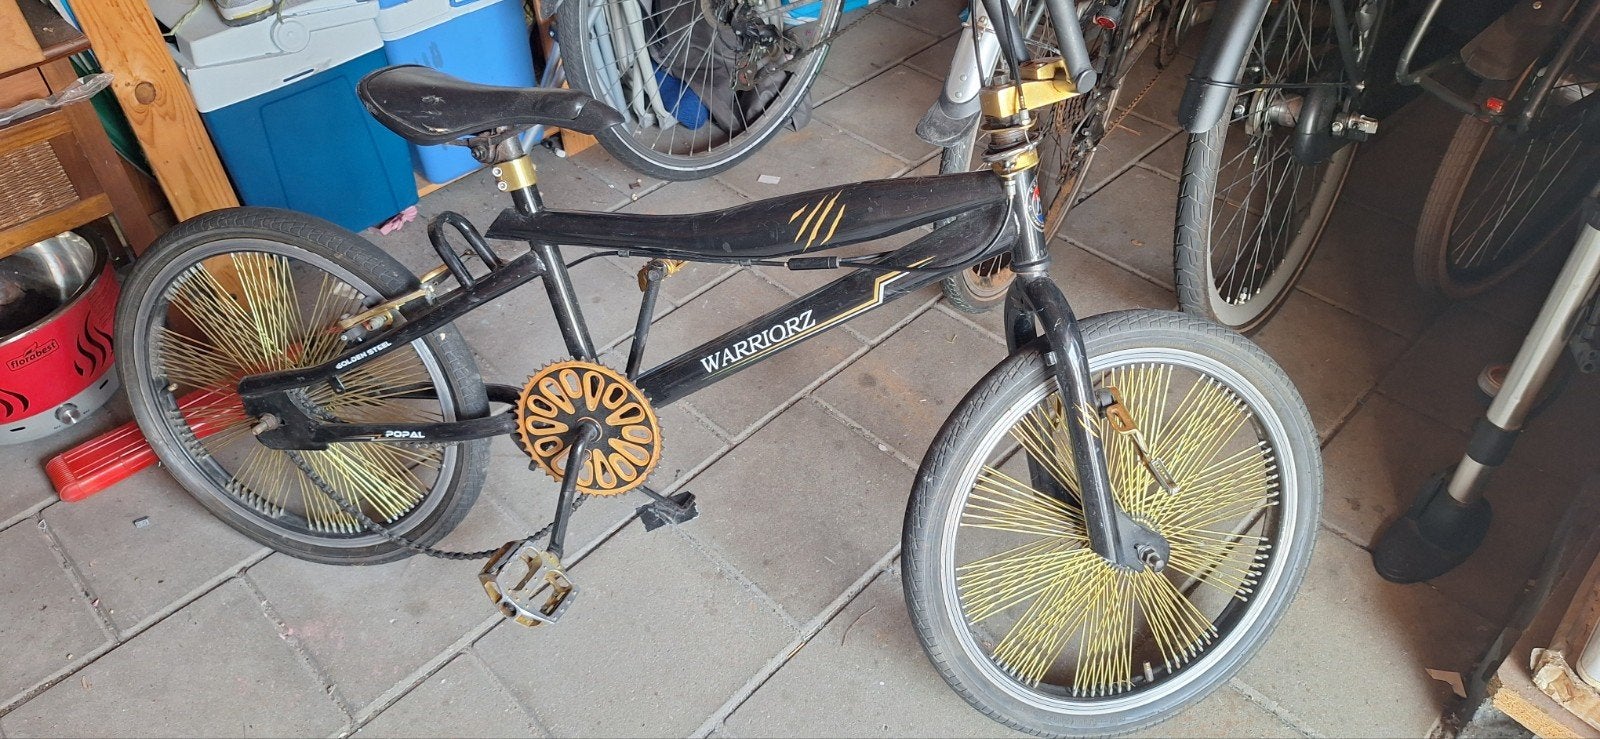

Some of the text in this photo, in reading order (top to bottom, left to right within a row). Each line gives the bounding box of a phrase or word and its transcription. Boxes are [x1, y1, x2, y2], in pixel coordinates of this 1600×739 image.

[700, 309, 816, 373] WARRIORZ
[10, 342, 56, 369] florabest
[335, 341, 392, 369] GOLDEN STEEL
[385, 430, 426, 439] POPAL
